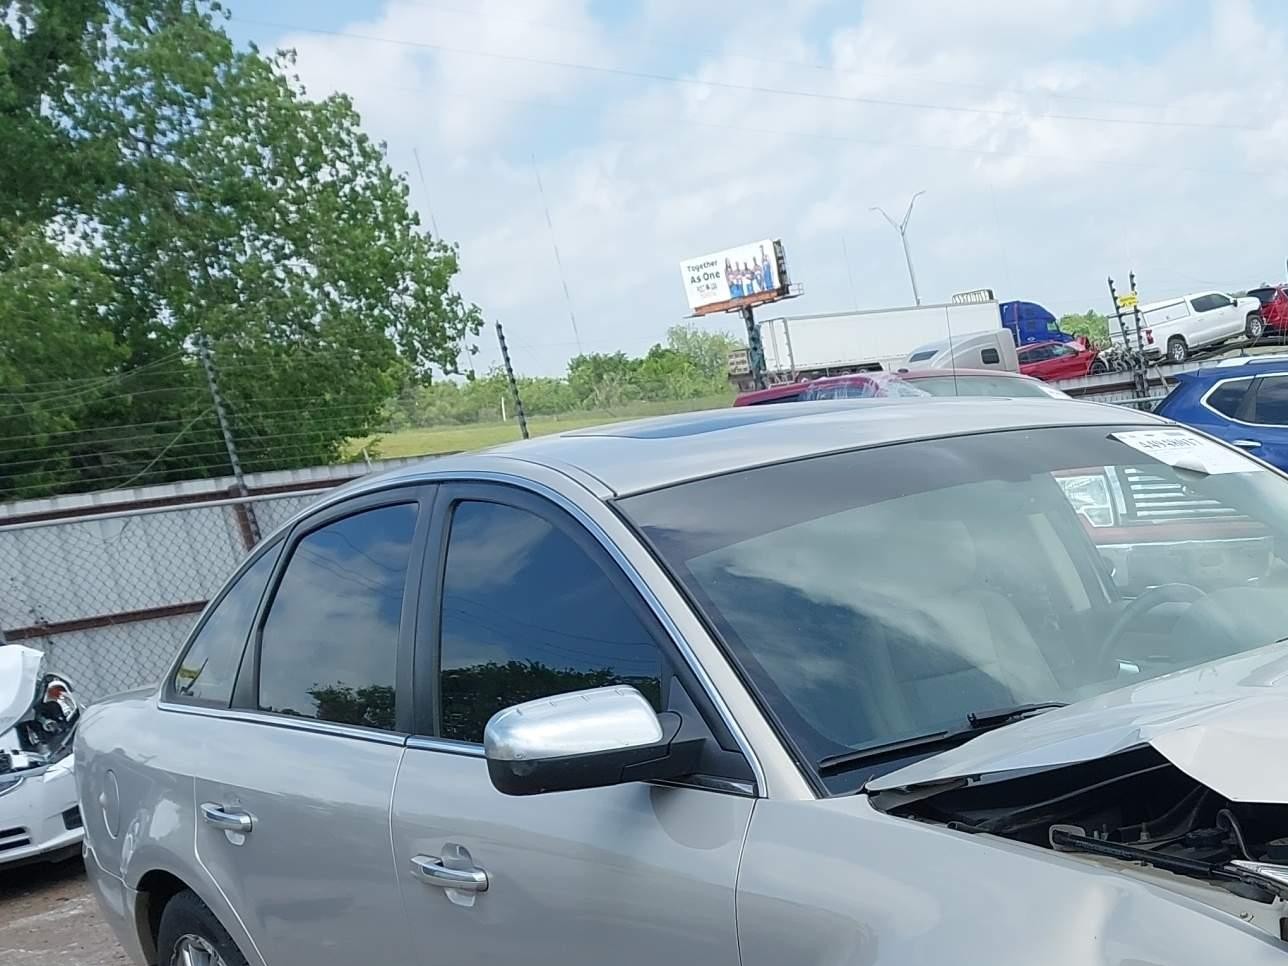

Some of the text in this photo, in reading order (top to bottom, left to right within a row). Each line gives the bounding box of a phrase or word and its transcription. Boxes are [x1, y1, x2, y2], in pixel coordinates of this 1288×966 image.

[687, 260, 718, 273] Together
[690, 271, 721, 284] As One
